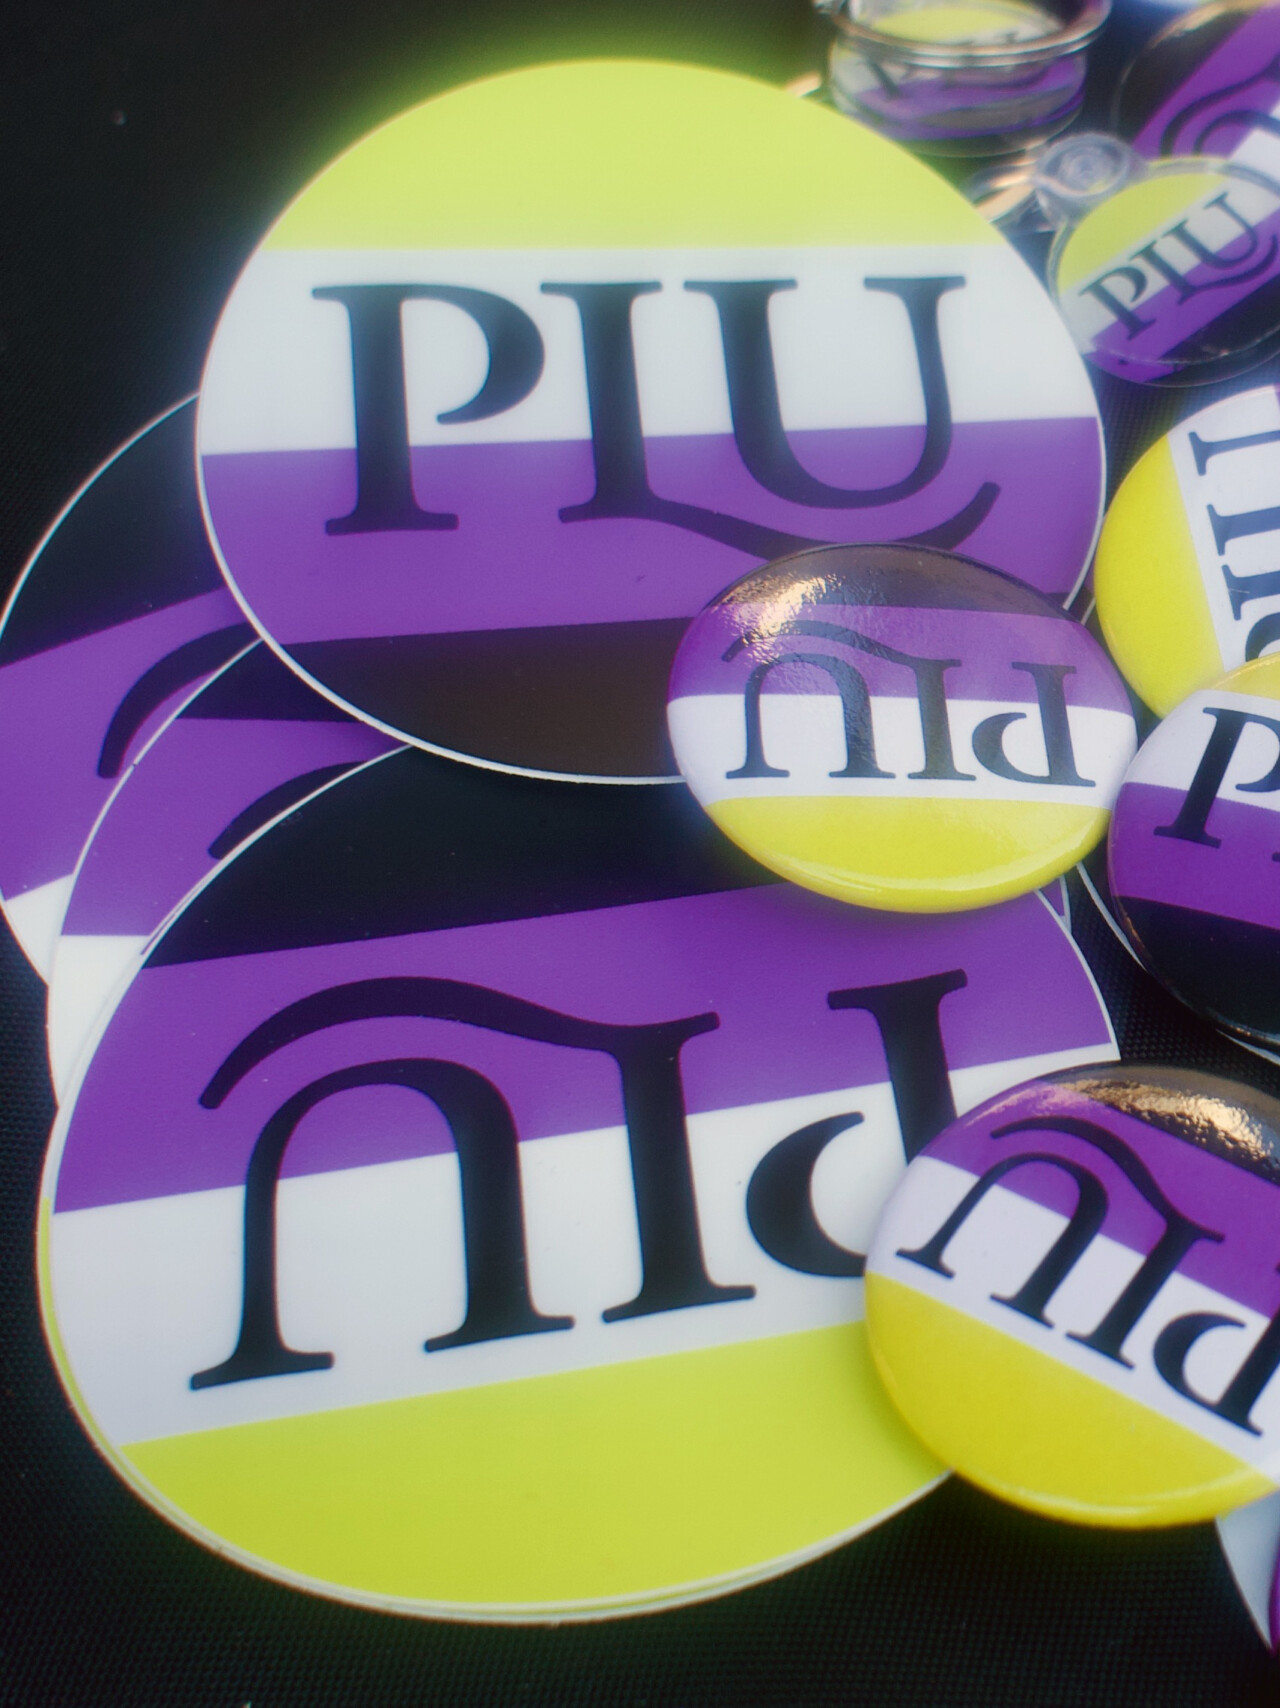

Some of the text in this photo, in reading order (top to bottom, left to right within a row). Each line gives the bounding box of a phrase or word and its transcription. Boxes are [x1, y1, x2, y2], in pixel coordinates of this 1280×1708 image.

[1077, 191, 1279, 341] PLU
[311, 277, 1000, 561] PLU
[721, 619, 1096, 787] PLU
